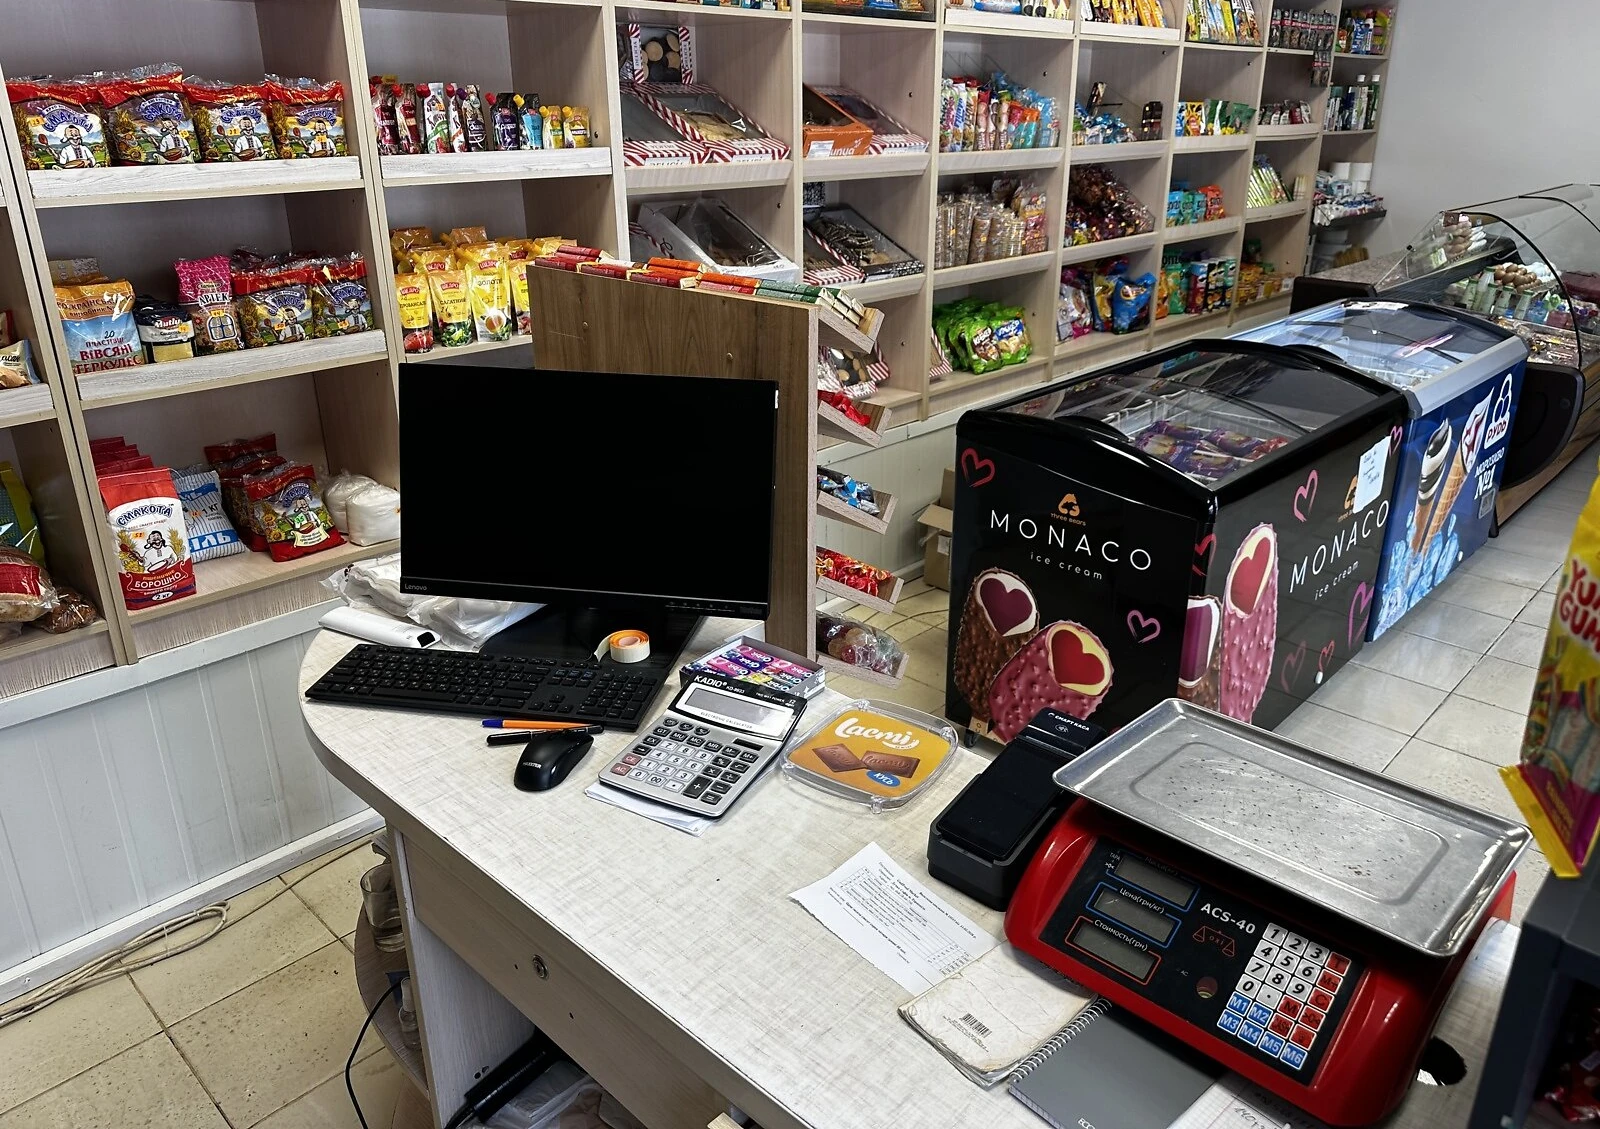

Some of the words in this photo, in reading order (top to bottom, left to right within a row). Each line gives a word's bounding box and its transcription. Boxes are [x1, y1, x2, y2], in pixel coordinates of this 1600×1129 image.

[79, 344, 133, 361] ВІВСЯНІ
[117, 504, 173, 527] СМАКОТА
[189, 532, 231, 552] ІЛЬ
[990, 509, 1152, 571] MONACO
[1289, 500, 1390, 594] MONACO
[134, 571, 182, 589] БОРОШНО
[1030, 551, 1051, 565] ice
[1058, 561, 1103, 580] cream
[404, 583, 428, 591] Lenovo
[1314, 584, 1329, 601] ice
[1332, 560, 1359, 586] cream
[1569, 558, 1600, 613] YU
[834, 717, 913, 746] Lacmi
[1054, 715, 1074, 726] СМАРТ
[655, 727, 667, 735] GT
[673, 732, 685, 741] MU
[690, 737, 702, 745] MC
[615, 765, 626, 773] AC
[650, 776, 662, 784] 00
[1118, 887, 1166, 915] Цена(грн/кг)
[1200, 902, 1257, 935] ACS-40
[1093, 919, 1149, 953] Стоимость(грн)
[1270, 928, 1280, 939] 1
[1288, 938, 1302, 950] 2
[1309, 947, 1323, 960] 3
[1260, 946, 1273, 958] 4
[1280, 956, 1294, 968] 5
[1301, 966, 1315, 978] 6
[1242, 980, 1255, 992] 0
[1250, 962, 1264, 973] 7
[1271, 973, 1284, 985] 8
[1292, 983, 1306, 995] 9
[1230, 995, 1247, 1012] M1
[1251, 1007, 1269, 1023] M2
[1220, 1014, 1237, 1030] M3
[1241, 1025, 1258, 1042] M4
[1262, 1035, 1281, 1053] M5
[1283, 1047, 1303, 1065] M6
